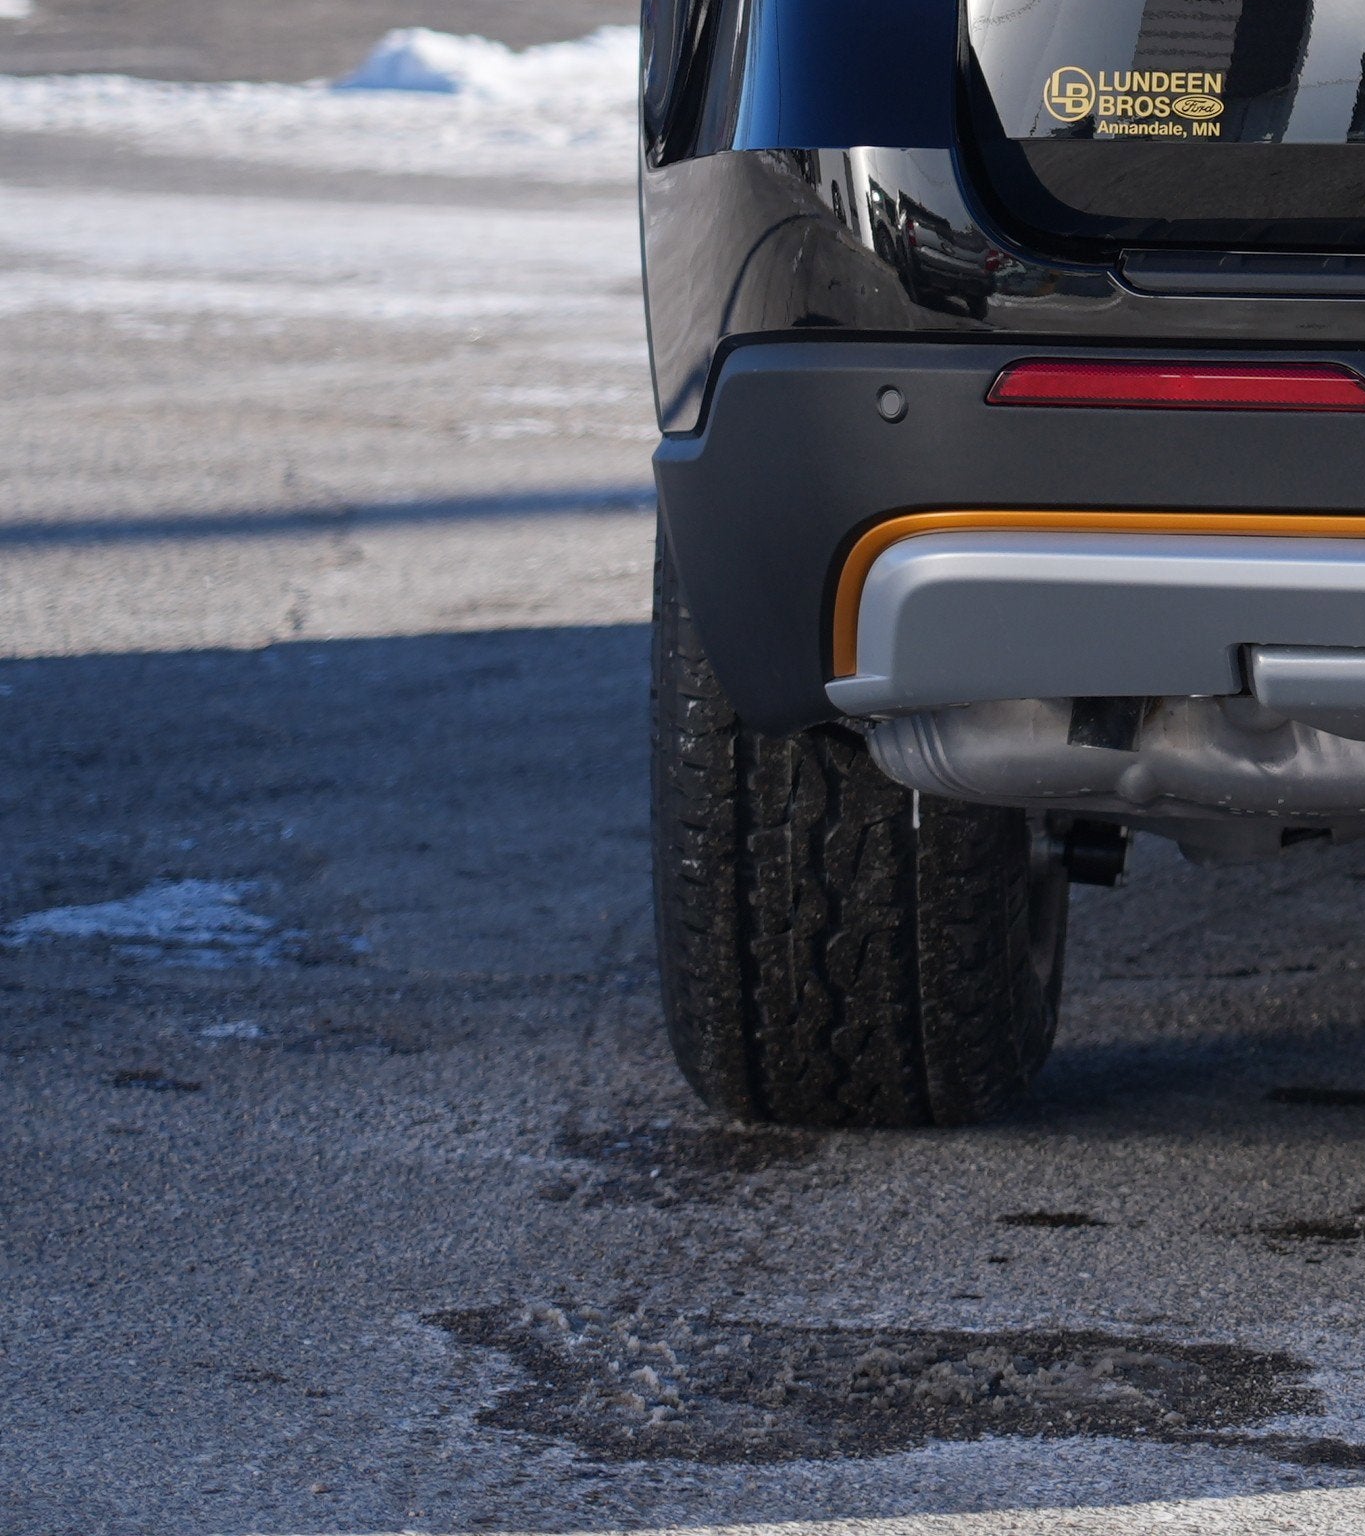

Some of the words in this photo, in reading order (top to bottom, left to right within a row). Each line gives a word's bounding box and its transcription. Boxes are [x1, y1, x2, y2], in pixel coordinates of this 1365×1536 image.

[1099, 70, 1222, 94] LUNDEEN
[1098, 95, 1171, 117] BROS
[1097, 119, 1187, 138] Annandale,
[1192, 122, 1220, 136] MN
